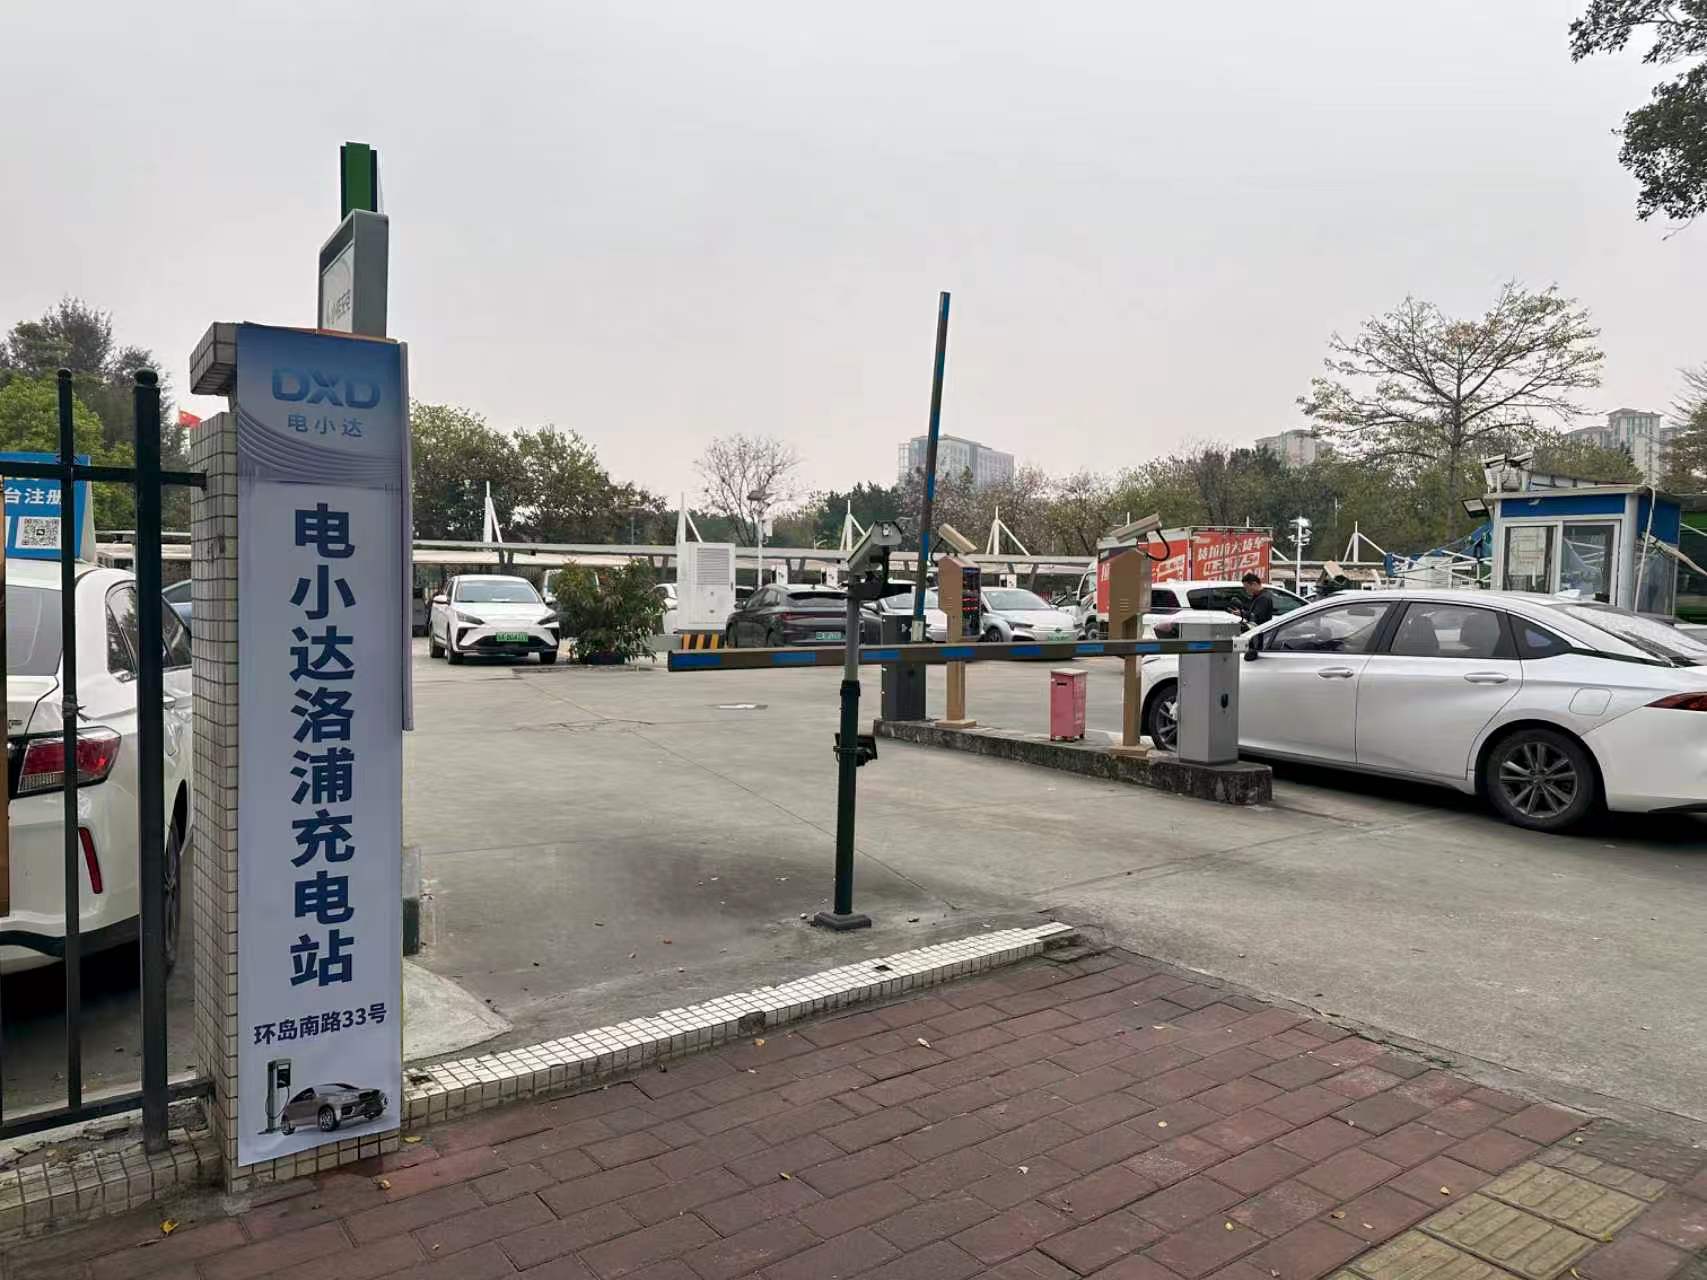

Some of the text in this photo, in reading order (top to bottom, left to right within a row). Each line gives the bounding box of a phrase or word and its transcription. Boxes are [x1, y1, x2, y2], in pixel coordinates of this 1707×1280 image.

[272, 368, 381, 409] DXD
[288, 414, 362, 437] 电小达
[289, 502, 356, 986] 电小达洛浦充电站
[253, 1002, 387, 1045] 环岛南路33号
